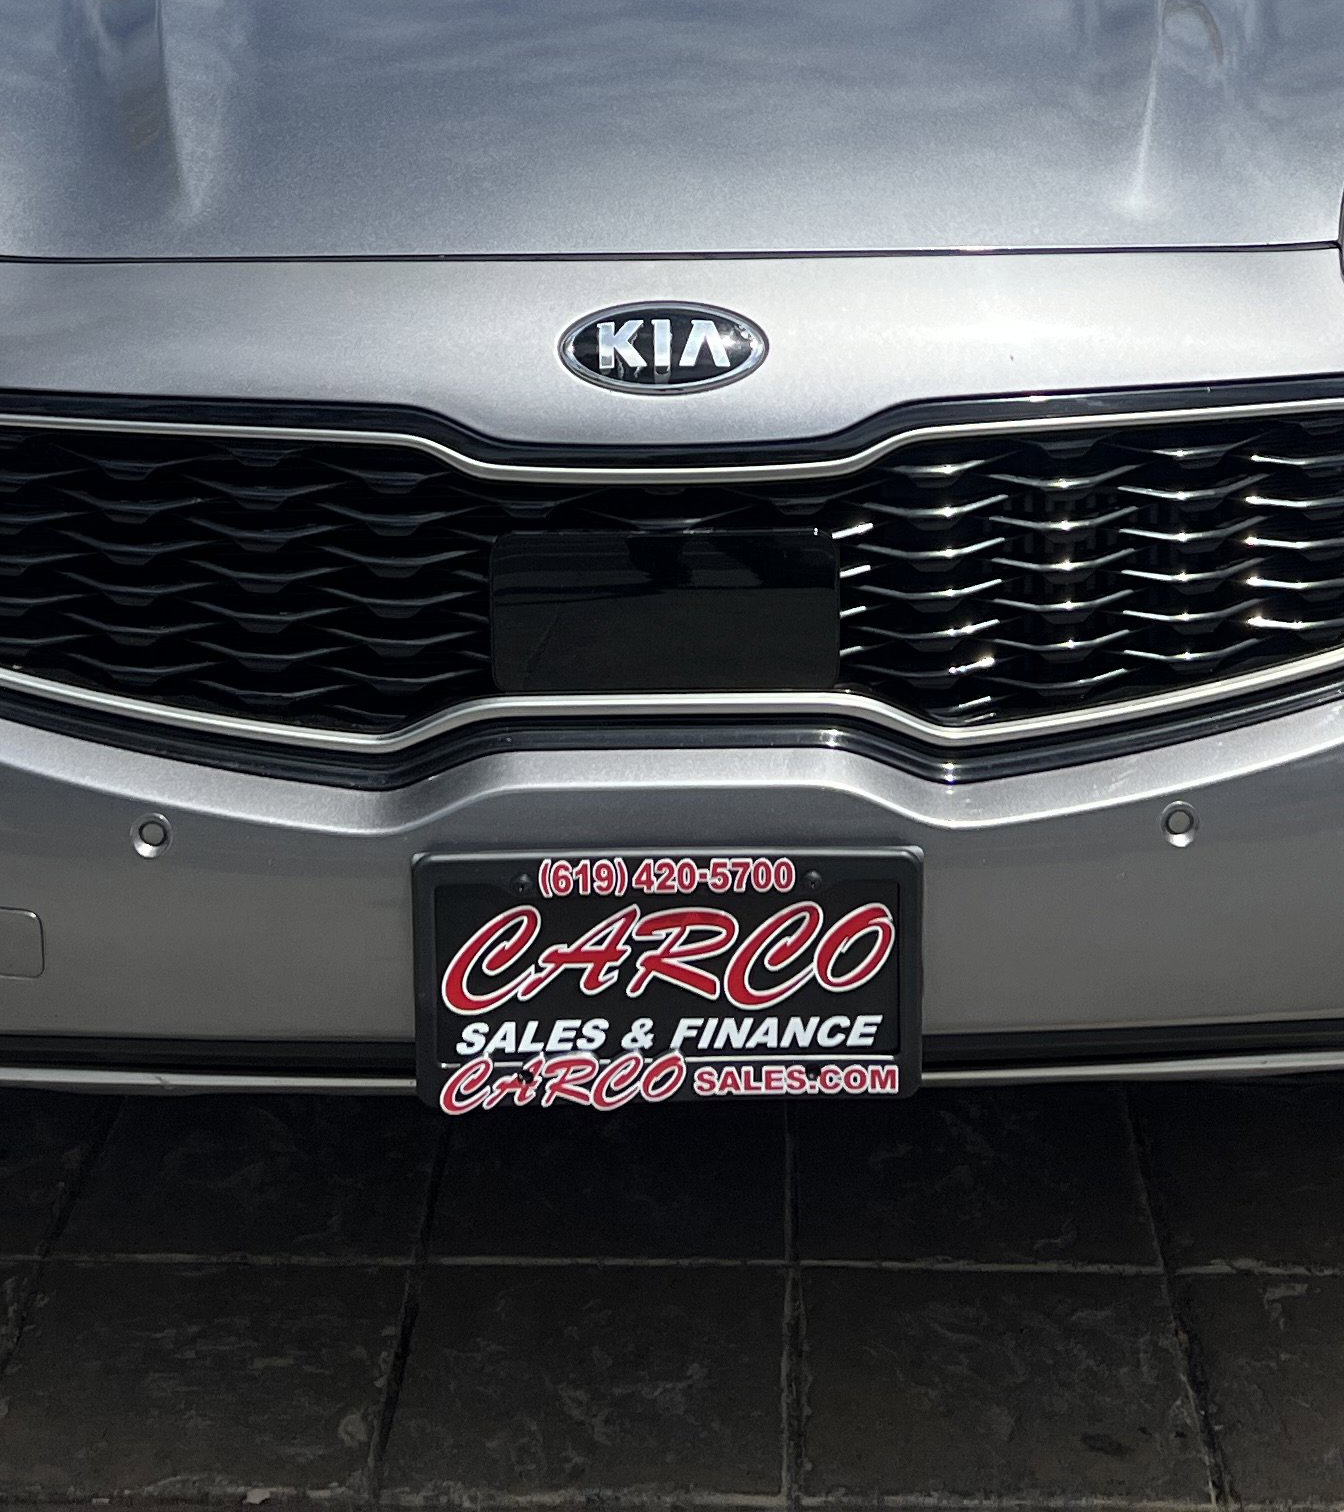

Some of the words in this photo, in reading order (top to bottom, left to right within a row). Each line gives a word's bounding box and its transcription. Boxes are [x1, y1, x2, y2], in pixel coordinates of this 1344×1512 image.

[596, 318, 731, 370] KIA
[538, 857, 627, 899] (619)
[632, 857, 796, 894] 420-5700
[441, 900, 896, 1016] CARCO
[456, 1018, 611, 1055] SALES
[620, 1017, 654, 1049] &
[669, 1015, 883, 1050] FINANCE
[439, 1052, 687, 1116] CARCO
[693, 1064, 900, 1095] SALES.COM
